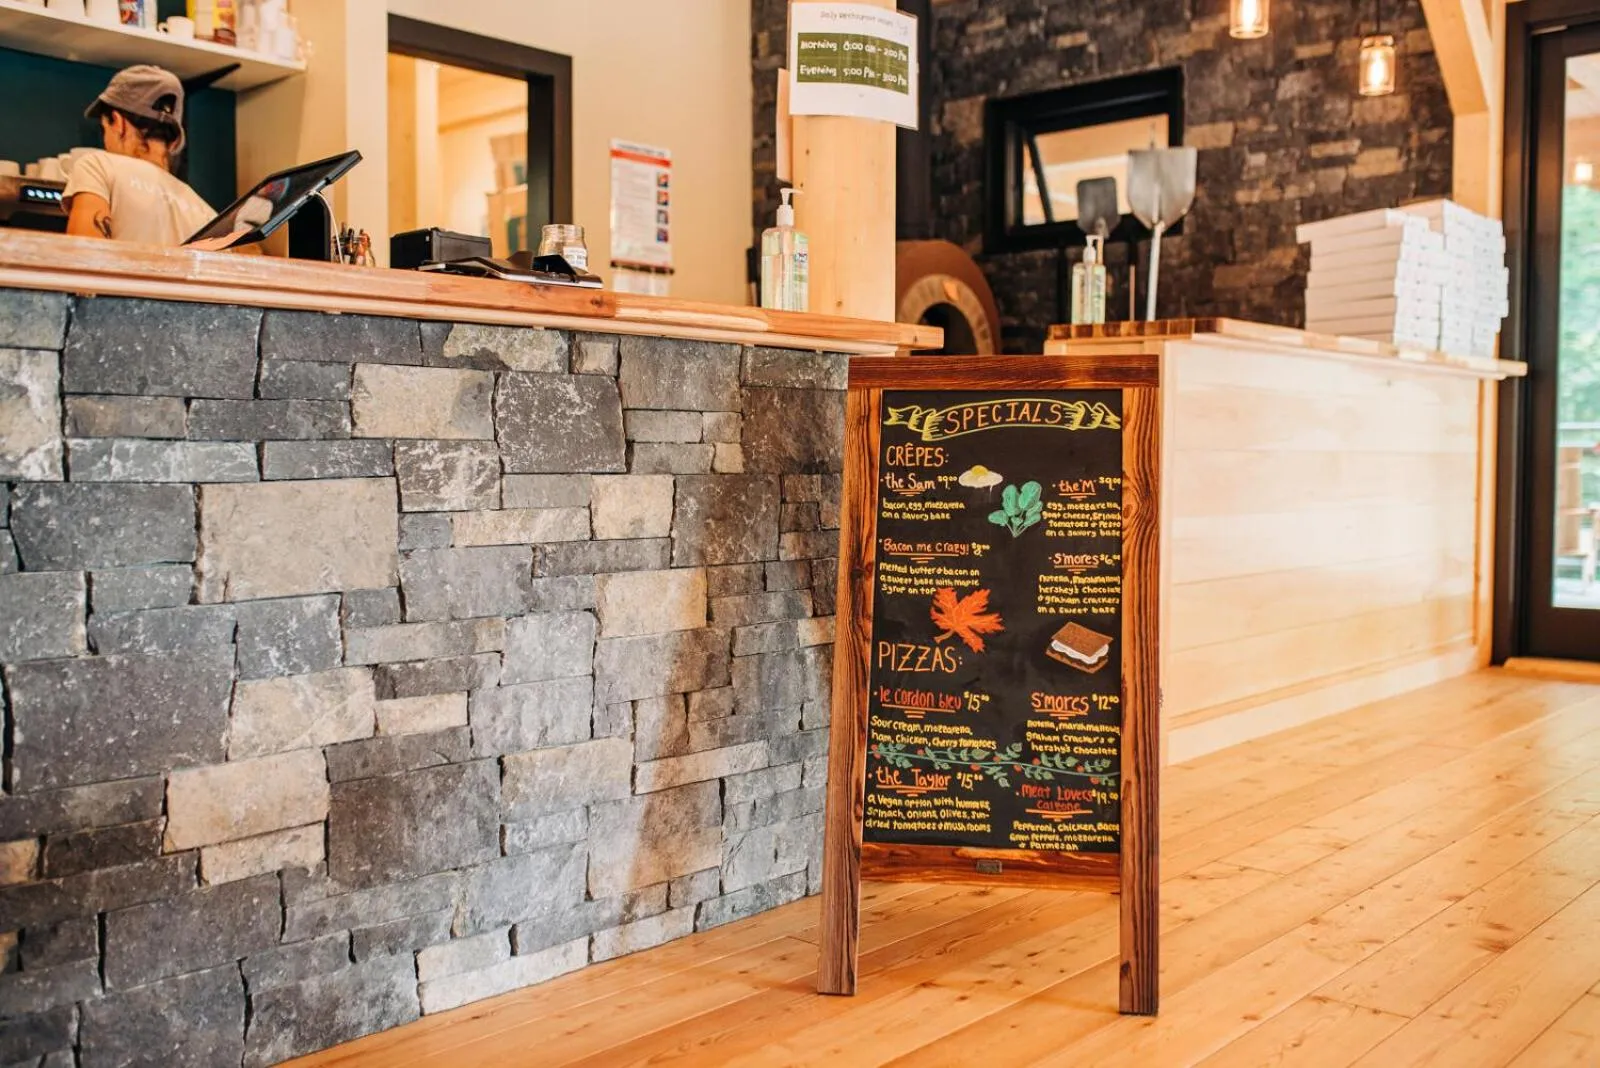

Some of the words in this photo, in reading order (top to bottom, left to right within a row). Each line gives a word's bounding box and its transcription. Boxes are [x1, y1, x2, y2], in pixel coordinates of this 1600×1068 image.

[799, 64, 837, 76] Evening
[944, 401, 1062, 434] SPECIALS
[886, 442, 949, 468] CRÊPES:
[884, 472, 904, 489] the
[908, 473, 936, 490] Sam
[1059, 480, 1079, 492] the
[1045, 529, 1057, 537] on
[883, 538, 913, 552] Bacon
[916, 543, 932, 552] me
[1053, 552, 1100, 565] S'mores
[943, 566, 968, 575] bacon
[878, 640, 963, 673] PIZZAS:
[880, 685, 891, 702] le
[938, 690, 962, 709] bleu
[1031, 691, 1090, 712] S'mores
[875, 766, 902, 785] the
[911, 768, 951, 788] Taylor
[904, 799, 932, 808] option
[933, 797, 954, 806] with
